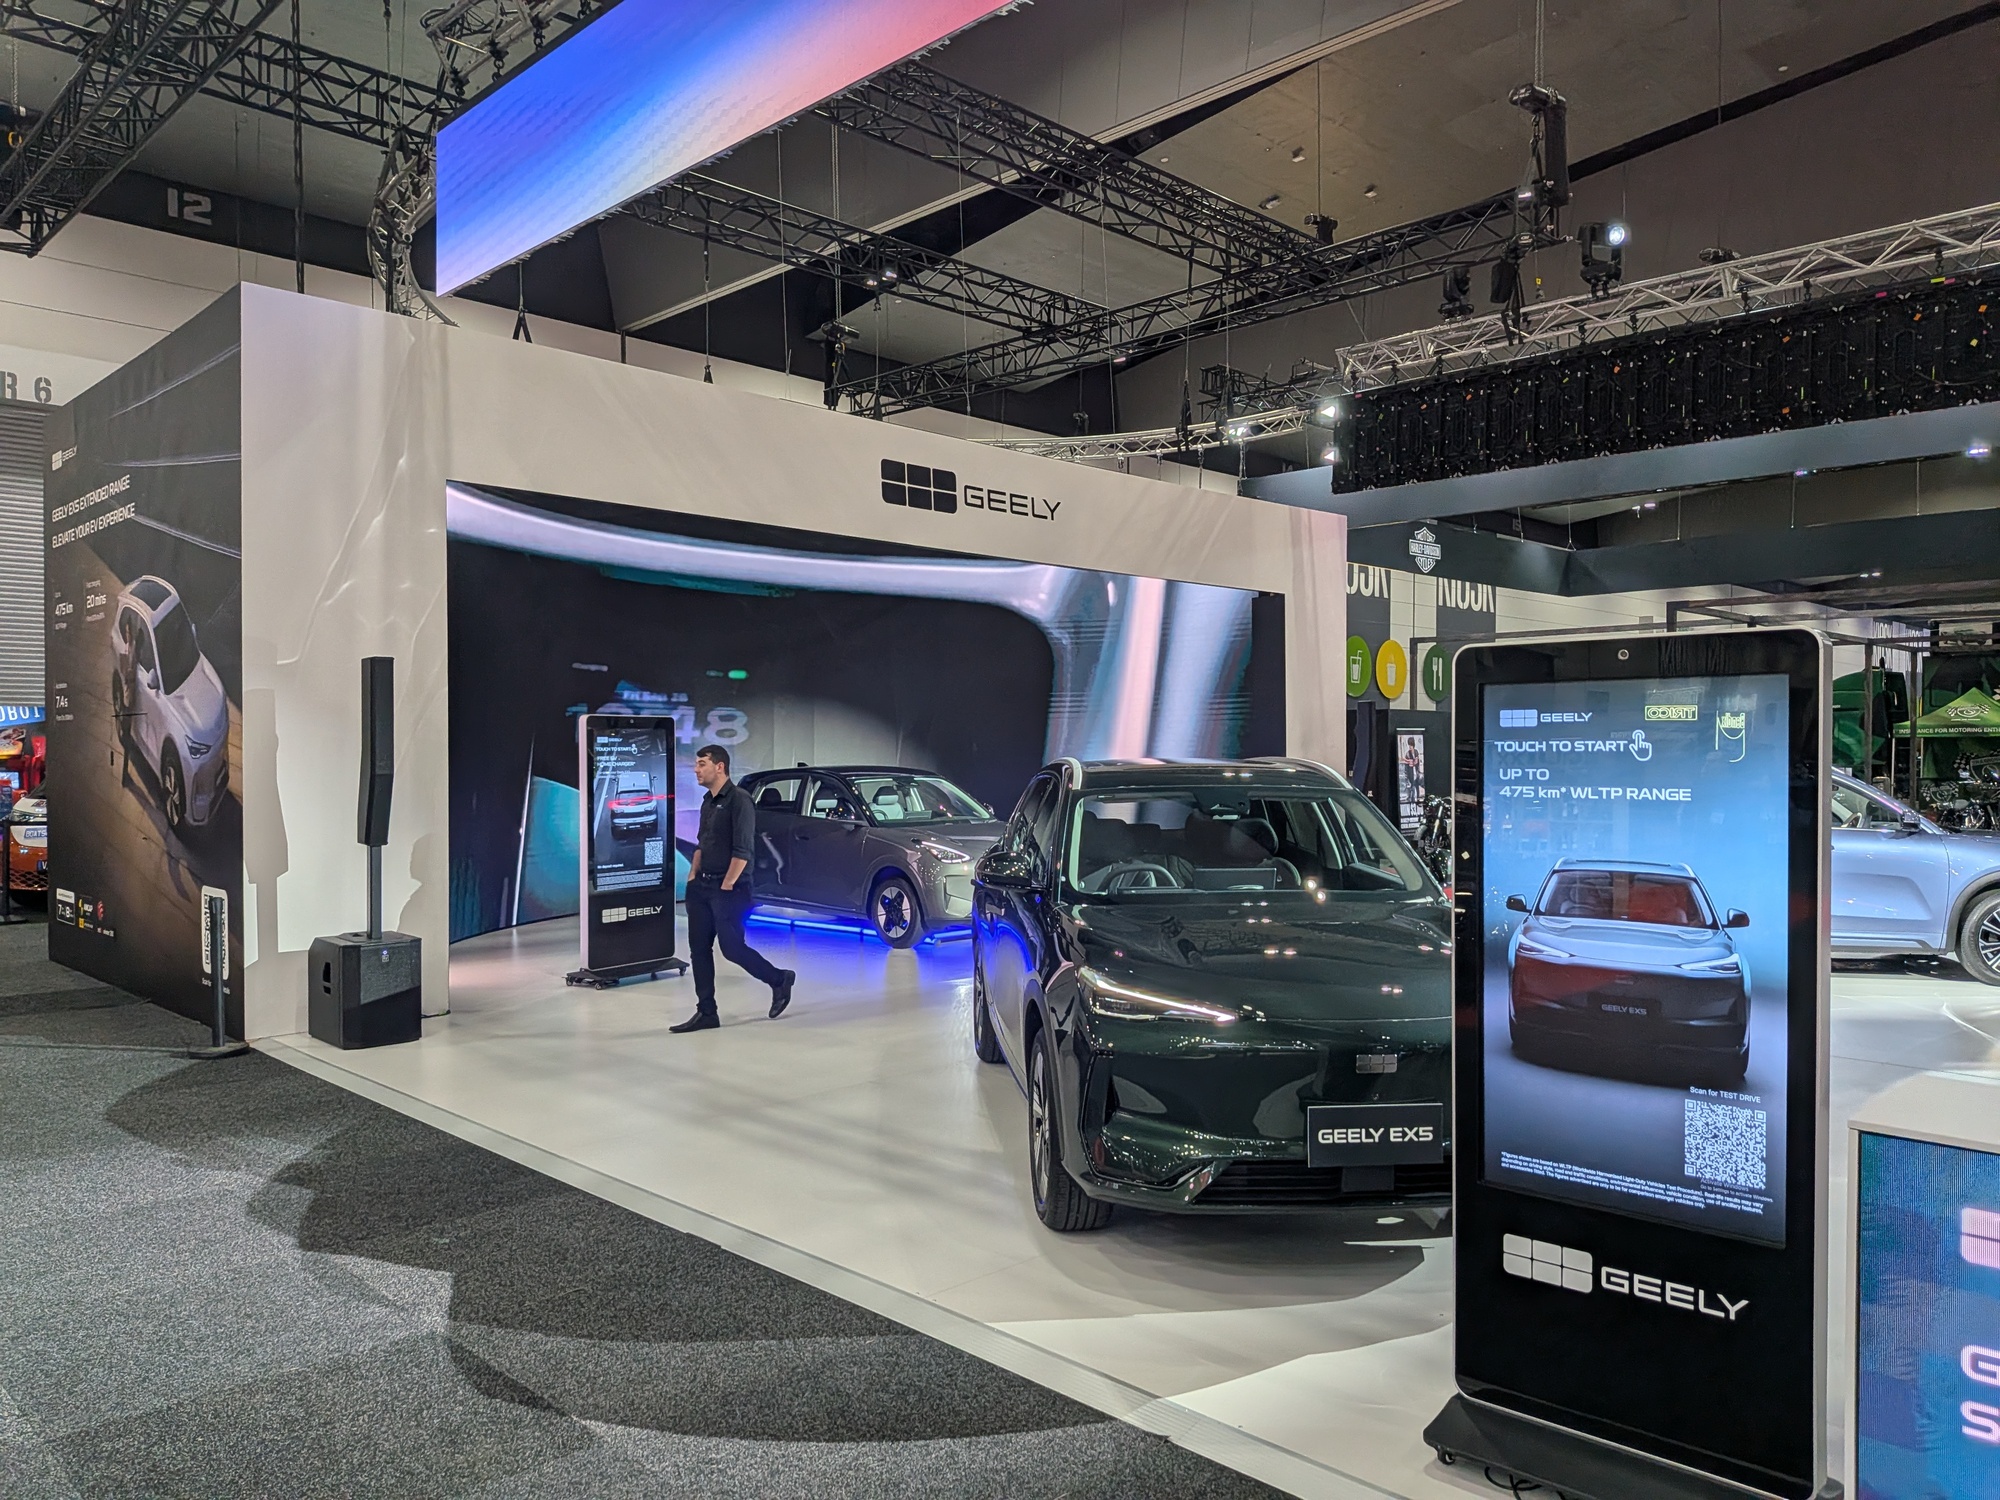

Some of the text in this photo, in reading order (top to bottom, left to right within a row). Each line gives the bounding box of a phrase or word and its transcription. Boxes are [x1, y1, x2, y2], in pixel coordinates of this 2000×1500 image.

[167, 187, 212, 226] 12
[34, 376, 52, 404] 6
[52, 505, 69, 522] GEELY
[80, 485, 108, 511] EXTENDED
[109, 474, 130, 497] RANGE
[963, 484, 1062, 521] GEELY
[52, 502, 136, 549] ELEVATE YOUR EV EXPERIENCE
[86, 592, 106, 608] 20 mins
[1540, 712, 1592, 722] GEELY
[1494, 740, 1628, 752] TOUCH TO START
[1500, 768, 1550, 780] UP TO
[1499, 786, 1534, 798] 475
[1570, 786, 1622, 800] WLTP
[1626, 788, 1692, 801] RANGE
[628, 906, 662, 917] GEELY
[1601, 1004, 1628, 1013] GEELY
[1690, 1086, 1760, 1104] Scan for TEST DRIVE
[1318, 1126, 1434, 1144] GEELY EX5
[1700, 1178, 1749, 1192] Activate Windows
[1712, 1186, 1730, 1194] Settings
[1601, 1266, 1749, 1320] GEELY
